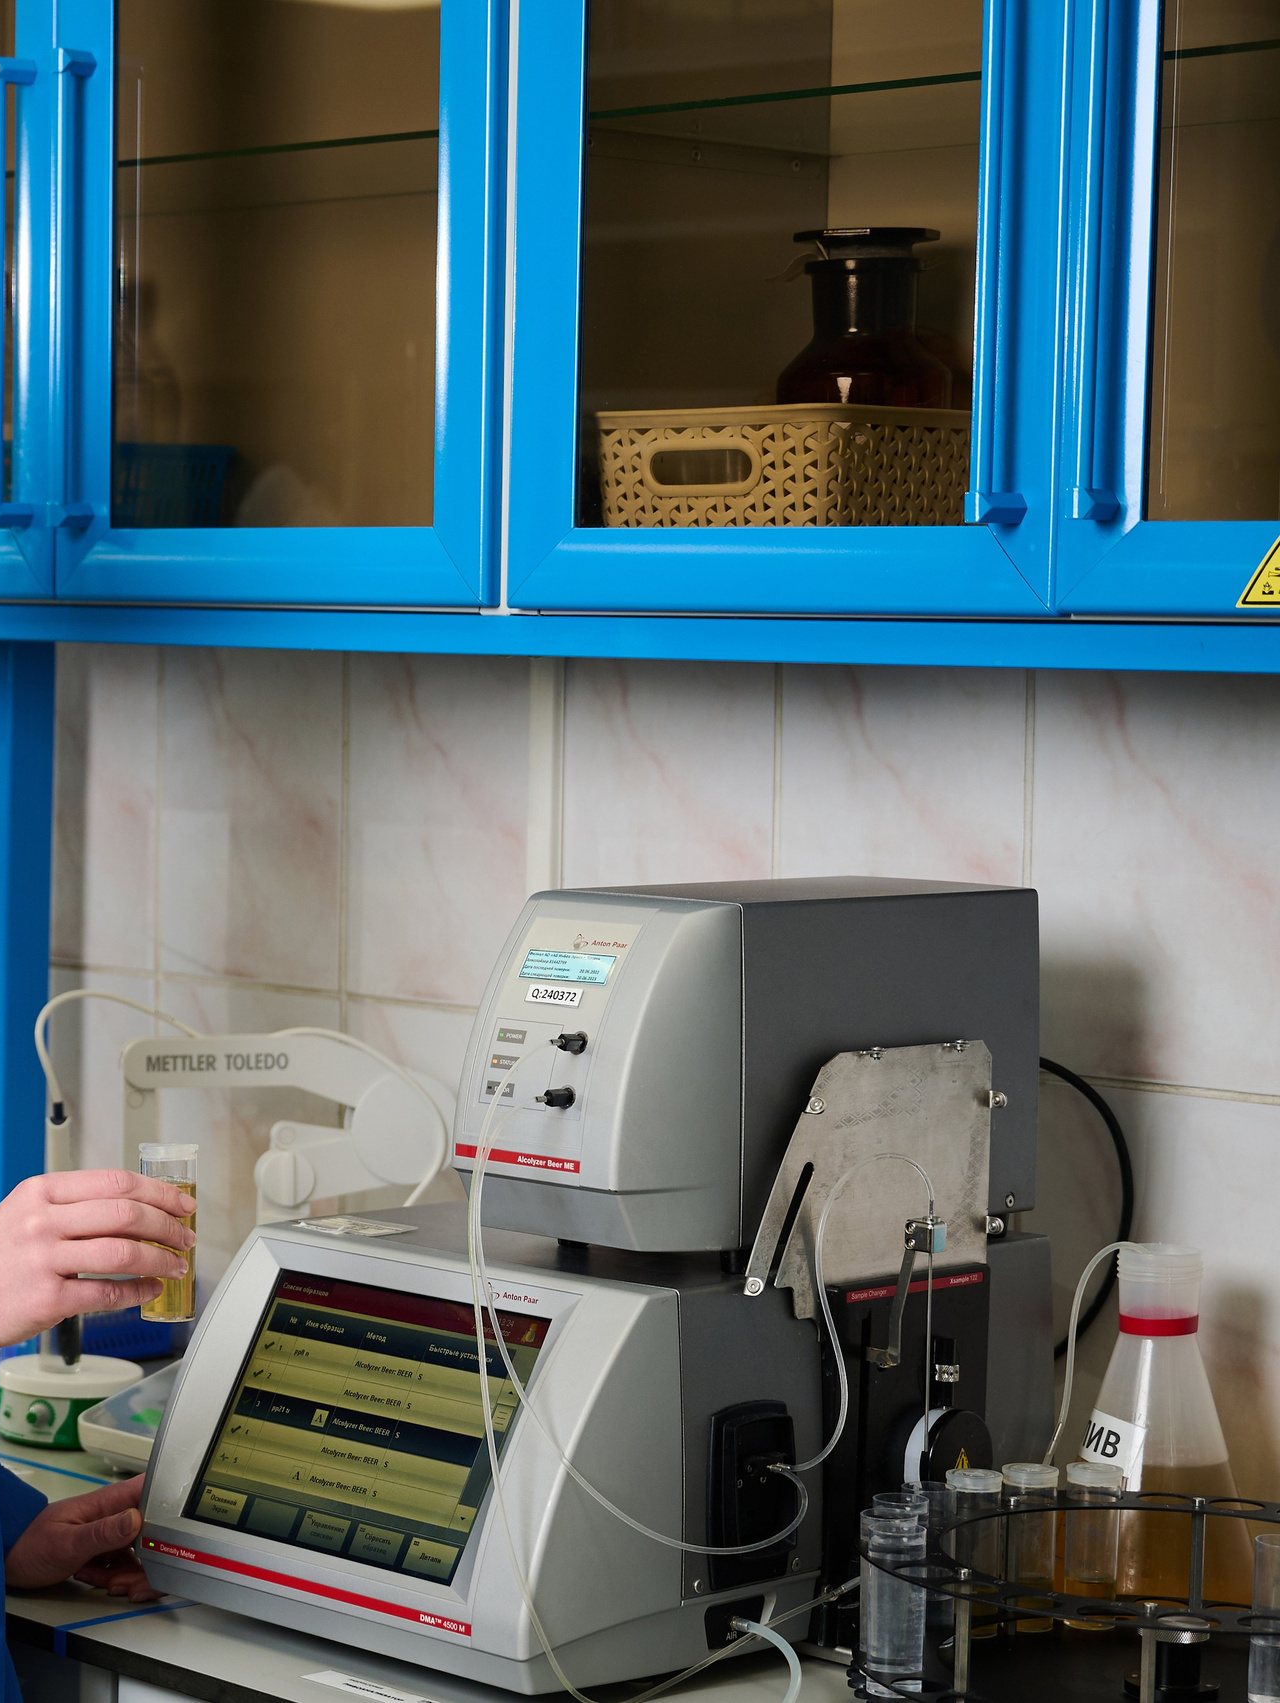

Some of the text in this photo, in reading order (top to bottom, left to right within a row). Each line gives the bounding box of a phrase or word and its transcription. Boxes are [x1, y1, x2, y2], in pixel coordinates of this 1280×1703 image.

[591, 939, 628, 949] Anton Paar
[531, 988, 577, 1003] Q:240372
[145, 1053, 289, 1072] METTLER TOLEDO
[517, 1155, 575, 1170] Alcolyzer Beer ME
[851, 1292, 868, 1301] Sample
[868, 1289, 887, 1298] Changer
[949, 1276, 970, 1285] Xsample
[502, 1291, 539, 1305] Anton Paar
[365, 1331, 388, 1343] Метод
[428, 1343, 460, 1357] Быстрые
[354, 1360, 381, 1373] Alcolyzer
[381, 1365, 396, 1376] Beer:
[396, 1368, 413, 1379] BEER
[417, 1373, 424, 1381] S
[343, 1389, 370, 1401] Alcolyzer
[370, 1394, 385, 1404] Beer:
[385, 1397, 402, 1408] BEER
[406, 1402, 412, 1410] S
[255, 1400, 261, 1408] 3
[331, 1417, 359, 1431] Alcolyzer
[358, 1423, 374, 1433] Beer:
[373, 1426, 391, 1437] BEER
[394, 1431, 401, 1439] S
[320, 1446, 347, 1459] Alcolyzer
[347, 1451, 363, 1462] Beer:
[362, 1455, 379, 1466] BEER
[383, 1460, 390, 1468] S
[309, 1475, 336, 1488] Alcolyzer
[336, 1481, 351, 1491] Beer:
[351, 1484, 368, 1495] BEER
[371, 1490, 378, 1498] S
[159, 1543, 196, 1560] Density Meter
[419, 1552, 442, 1564] Детали
[442, 1620, 458, 1631] 4500
[458, 1624, 465, 1633] M
[725, 1631, 738, 1641] AIR
